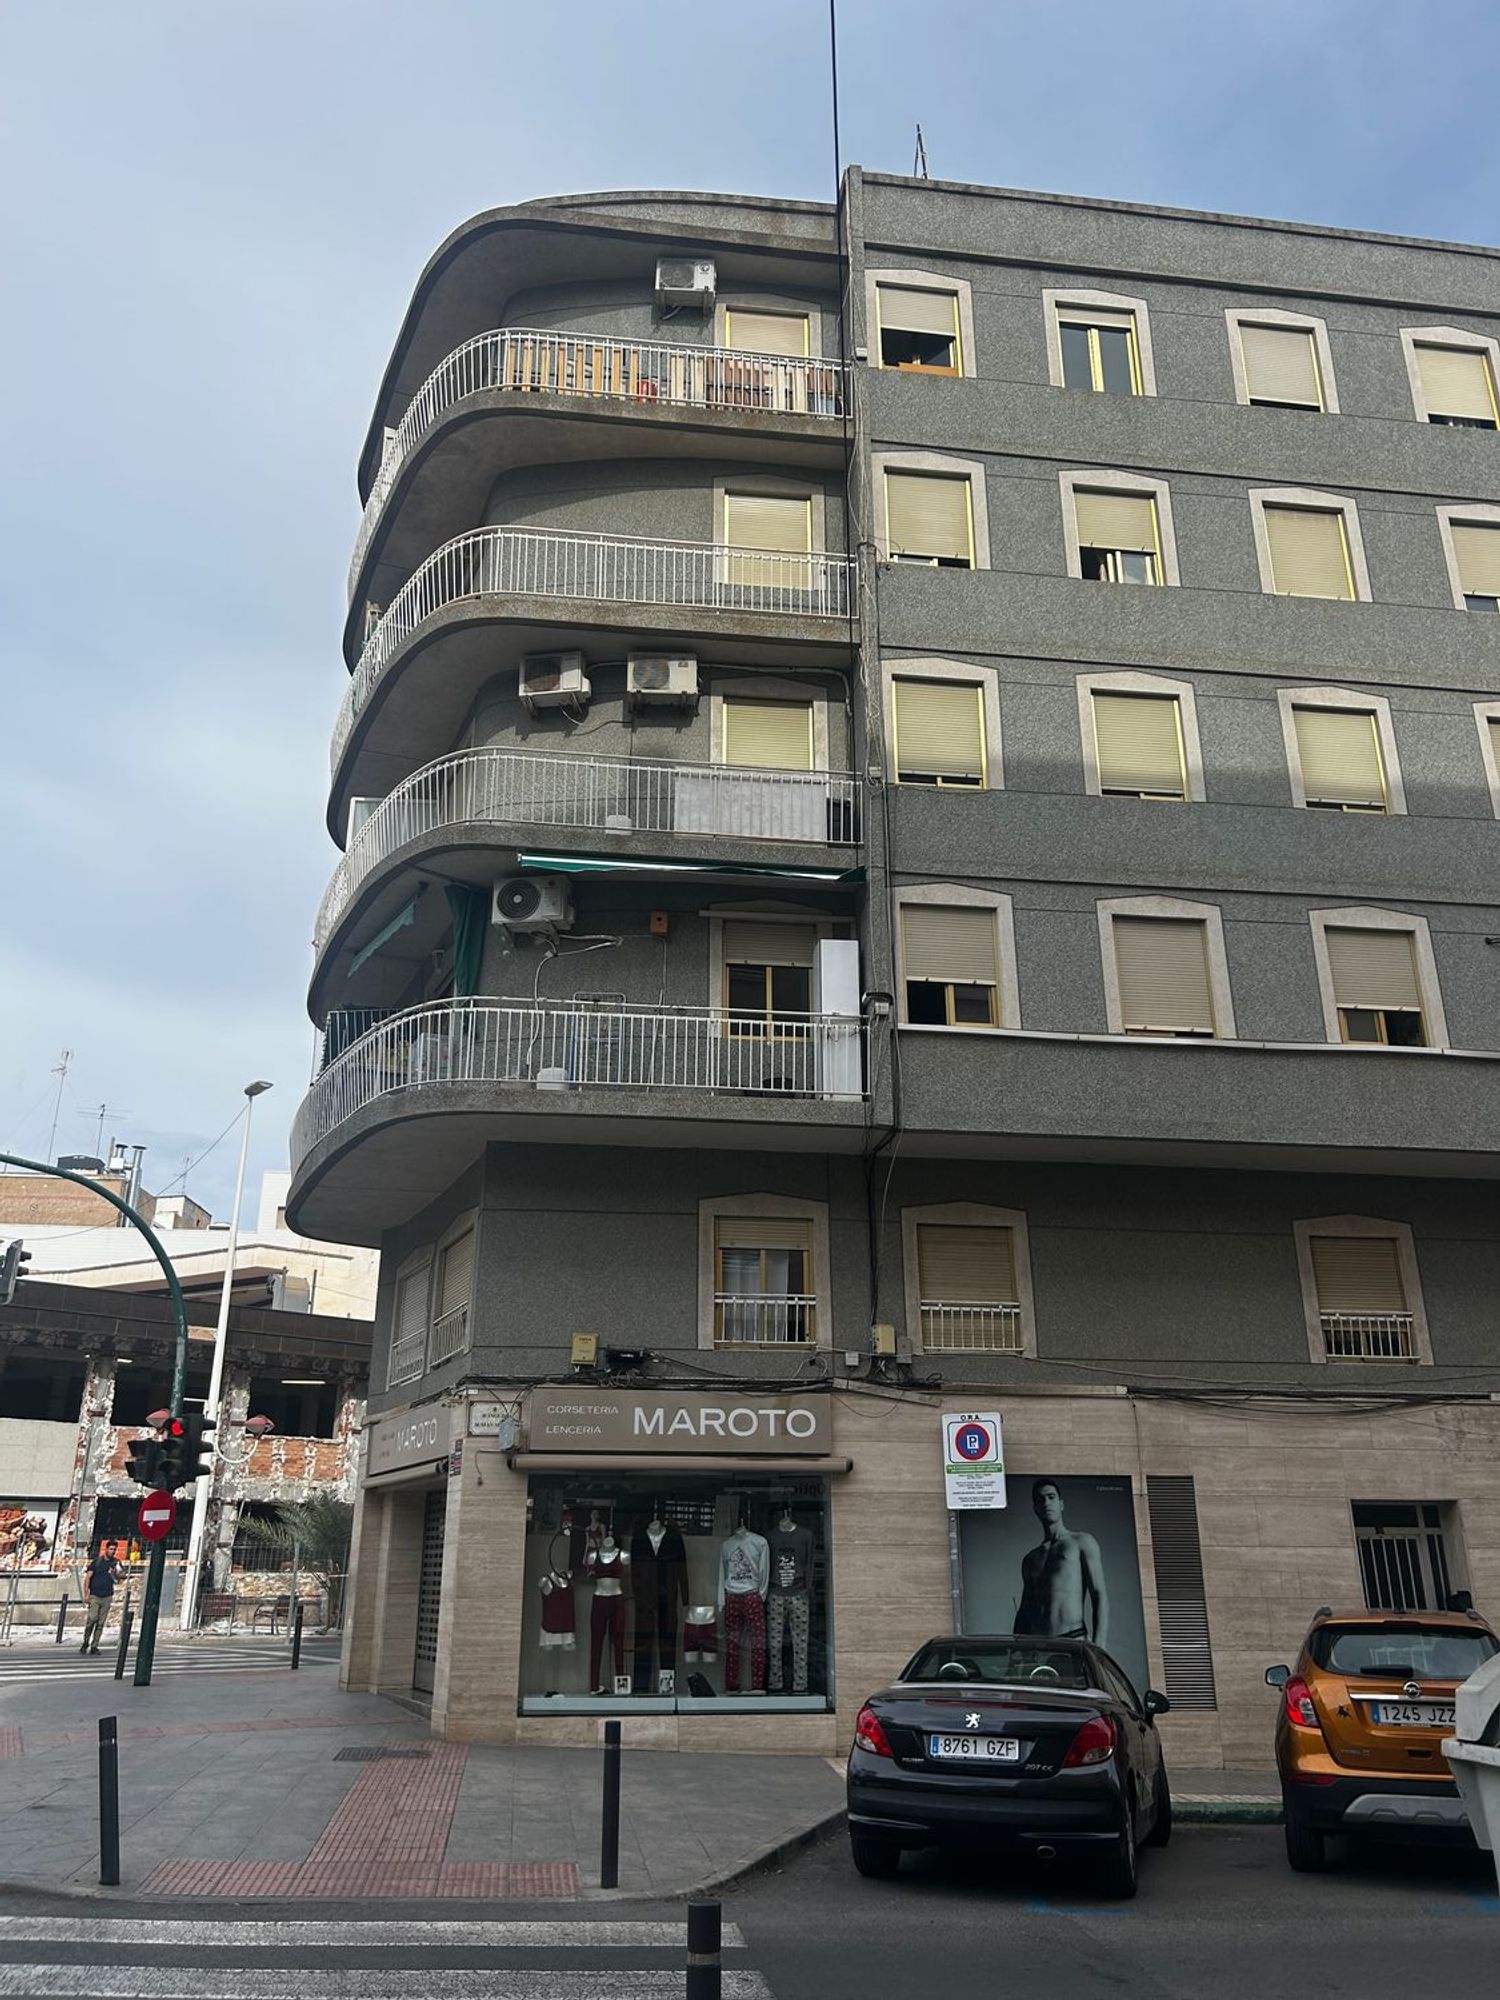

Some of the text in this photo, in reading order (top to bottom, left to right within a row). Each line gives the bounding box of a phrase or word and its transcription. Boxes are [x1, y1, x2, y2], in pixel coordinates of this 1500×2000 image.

[546, 1405, 620, 1415] CORSETERIA
[633, 1406, 817, 1438] MAROTO
[545, 1424, 602, 1435] LENCERIA
[969, 1436, 977, 1447] P
[1382, 1706, 1456, 1723] 1245 JZZ
[943, 1737, 1015, 1757] 8761 GZF
